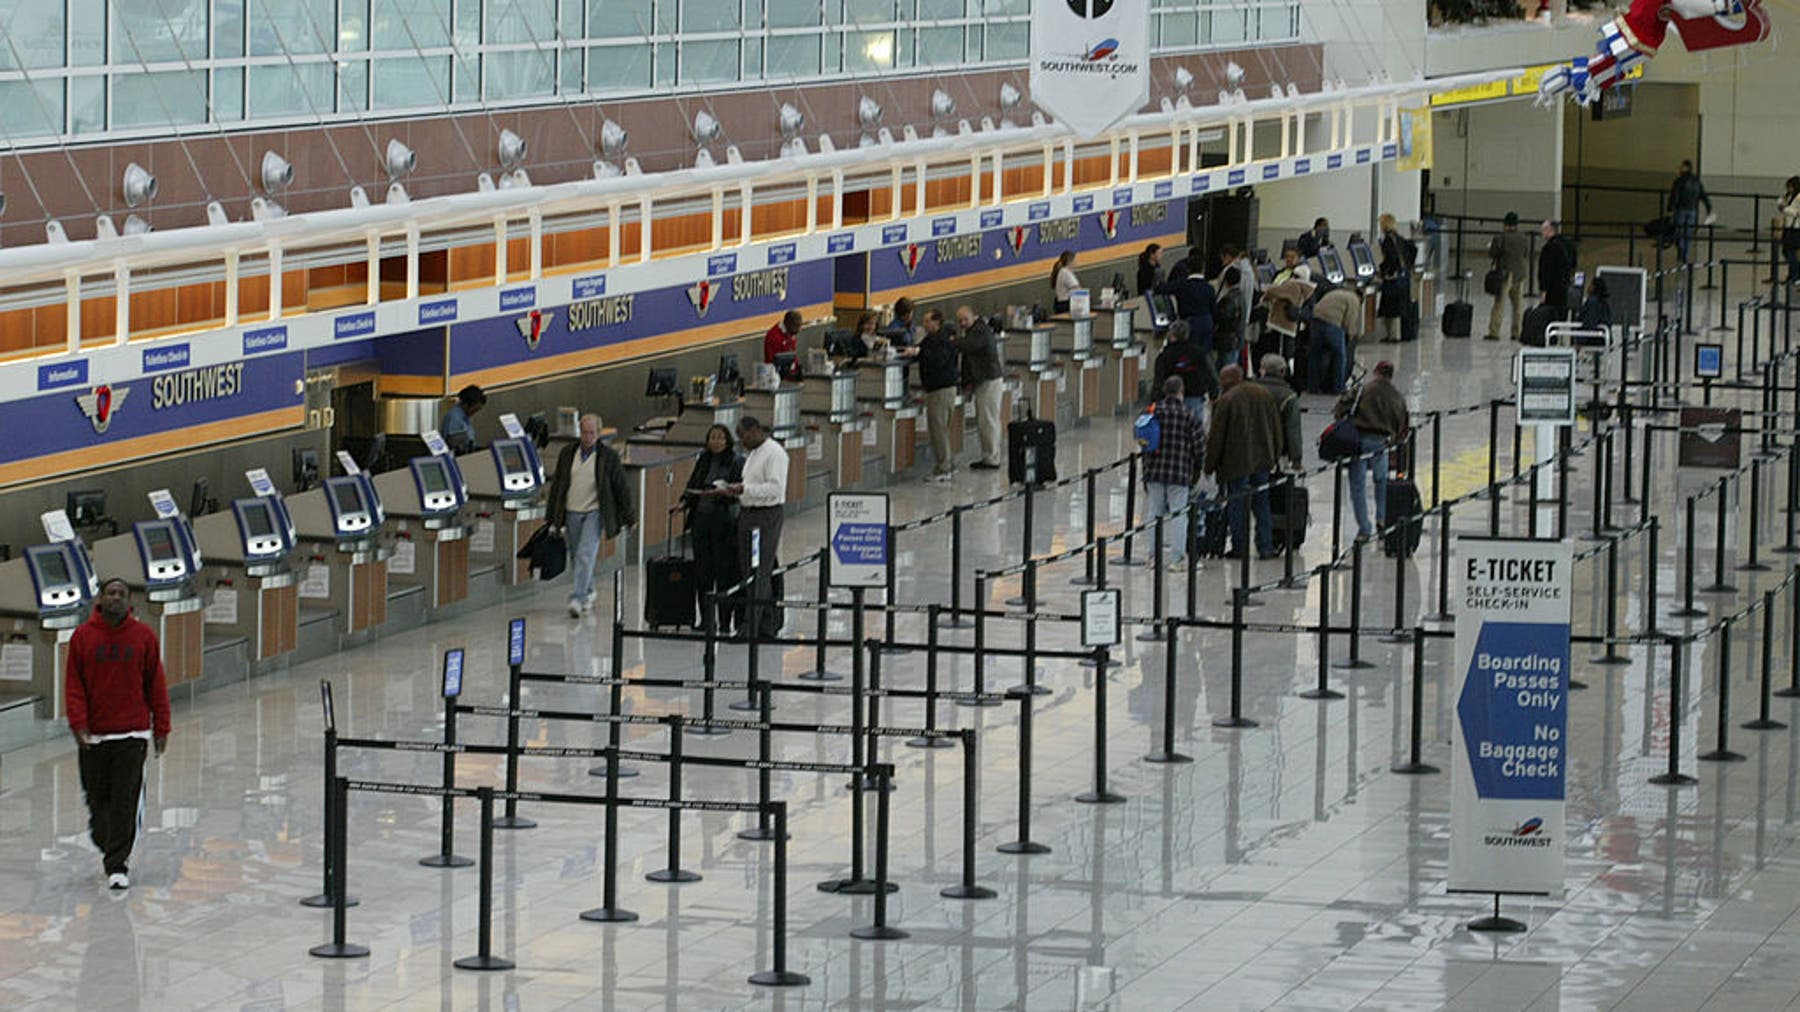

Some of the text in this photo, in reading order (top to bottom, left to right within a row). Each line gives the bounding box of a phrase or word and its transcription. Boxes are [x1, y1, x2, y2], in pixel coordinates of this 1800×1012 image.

[1040, 61, 1138, 74] SOUTHWEST.COM
[936, 233, 983, 263] SOUTHWEST
[732, 267, 789, 302] SOUTHWEST
[568, 294, 635, 332] SOUTHWEST
[152, 362, 244, 410] SOUTHWEST
[850, 526, 882, 535] Boarding
[852, 544, 882, 553] Baggage
[861, 551, 882, 560] Check
[1467, 557, 1556, 583] E-TICKET
[1466, 585, 1562, 599] SELF-SERVICE
[1466, 598, 1530, 610] CHECK-IN
[1477, 653, 1561, 675] Boarding
[1493, 672, 1560, 690] Passes
[1516, 690, 1561, 712] Only
[1534, 724, 1560, 742] No
[1479, 742, 1559, 762] Baggage
[1502, 760, 1559, 778] Check
[1484, 835, 1552, 848] SOUTHWEST
